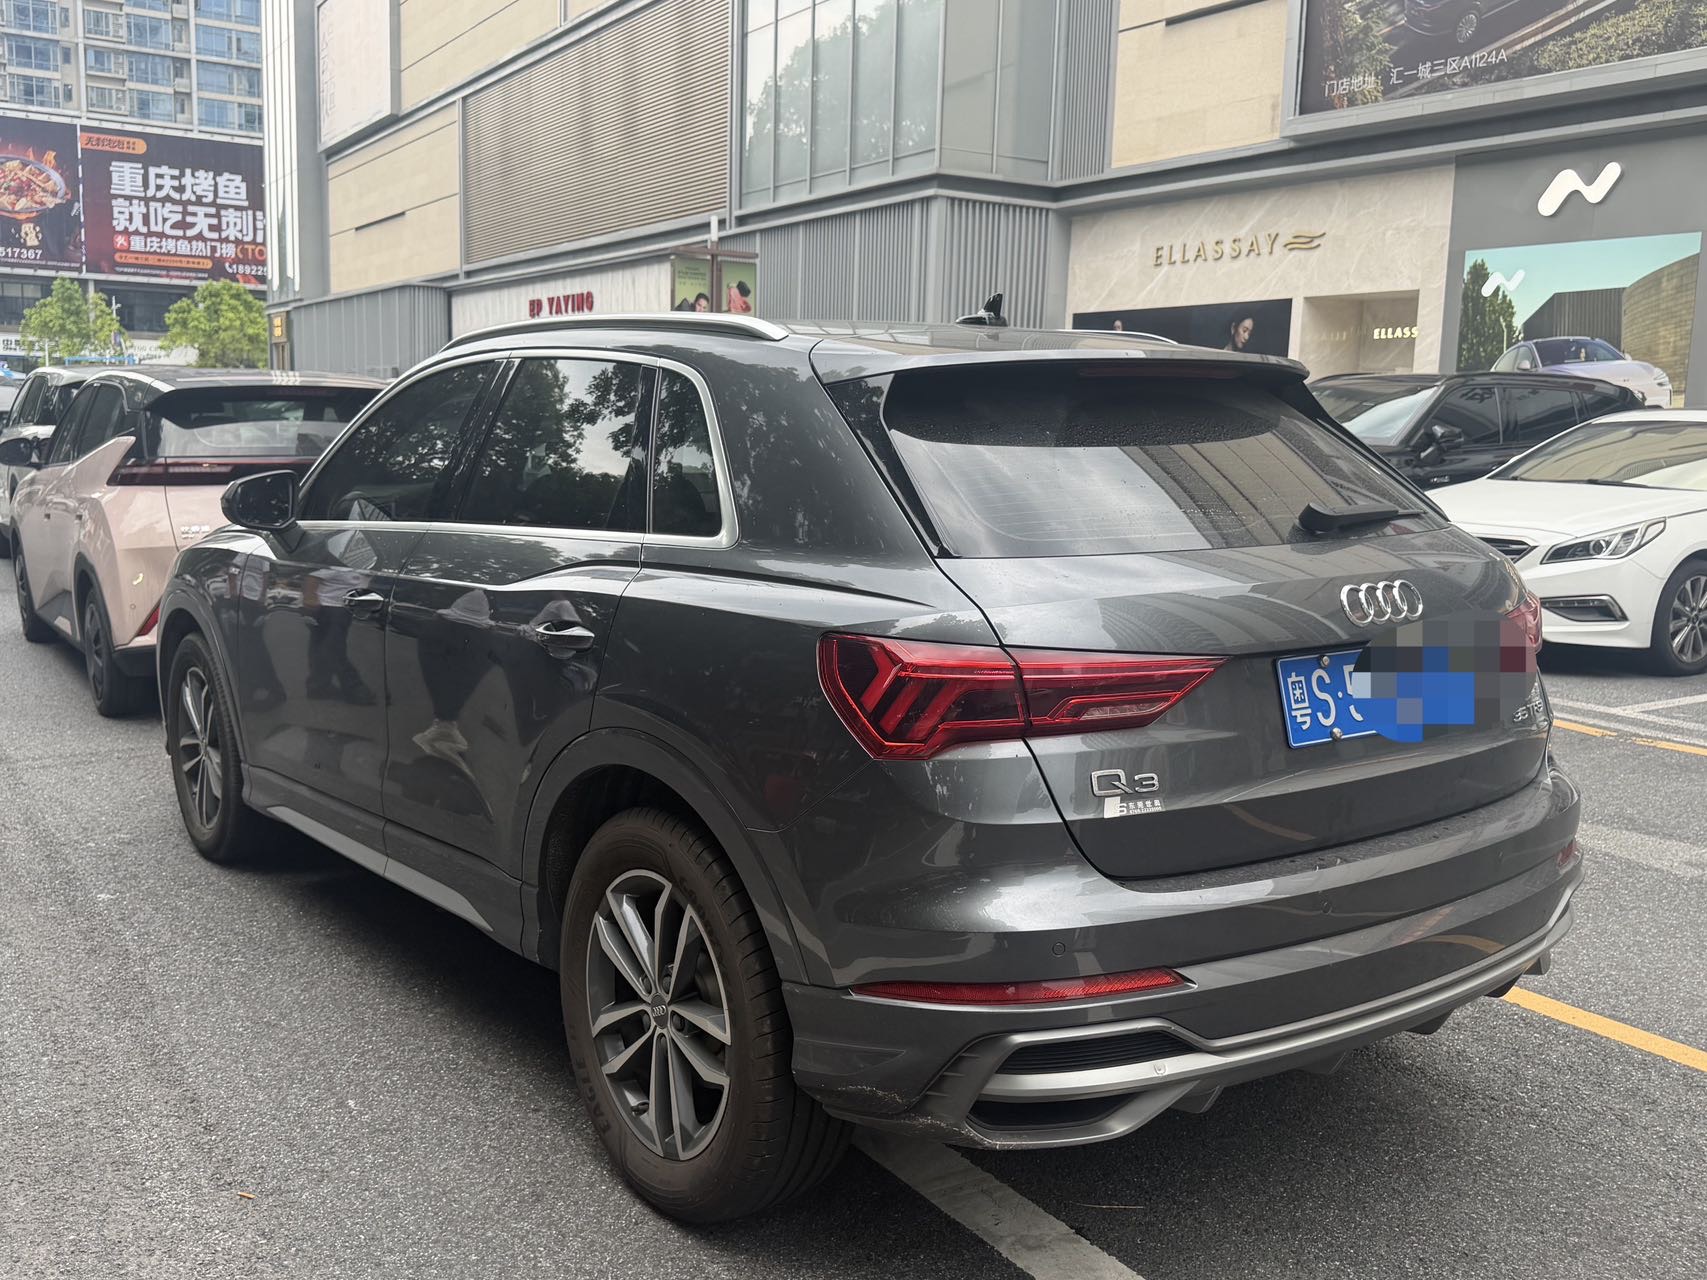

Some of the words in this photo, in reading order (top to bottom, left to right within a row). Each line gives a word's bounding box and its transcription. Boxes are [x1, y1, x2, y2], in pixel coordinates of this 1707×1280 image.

[109, 160, 249, 207] 重庆烤鱼
[1153, 232, 1280, 267] ELLASSAY
[1373, 326, 1419, 340] ELLASS
[1090, 768, 1160, 797] Q3
